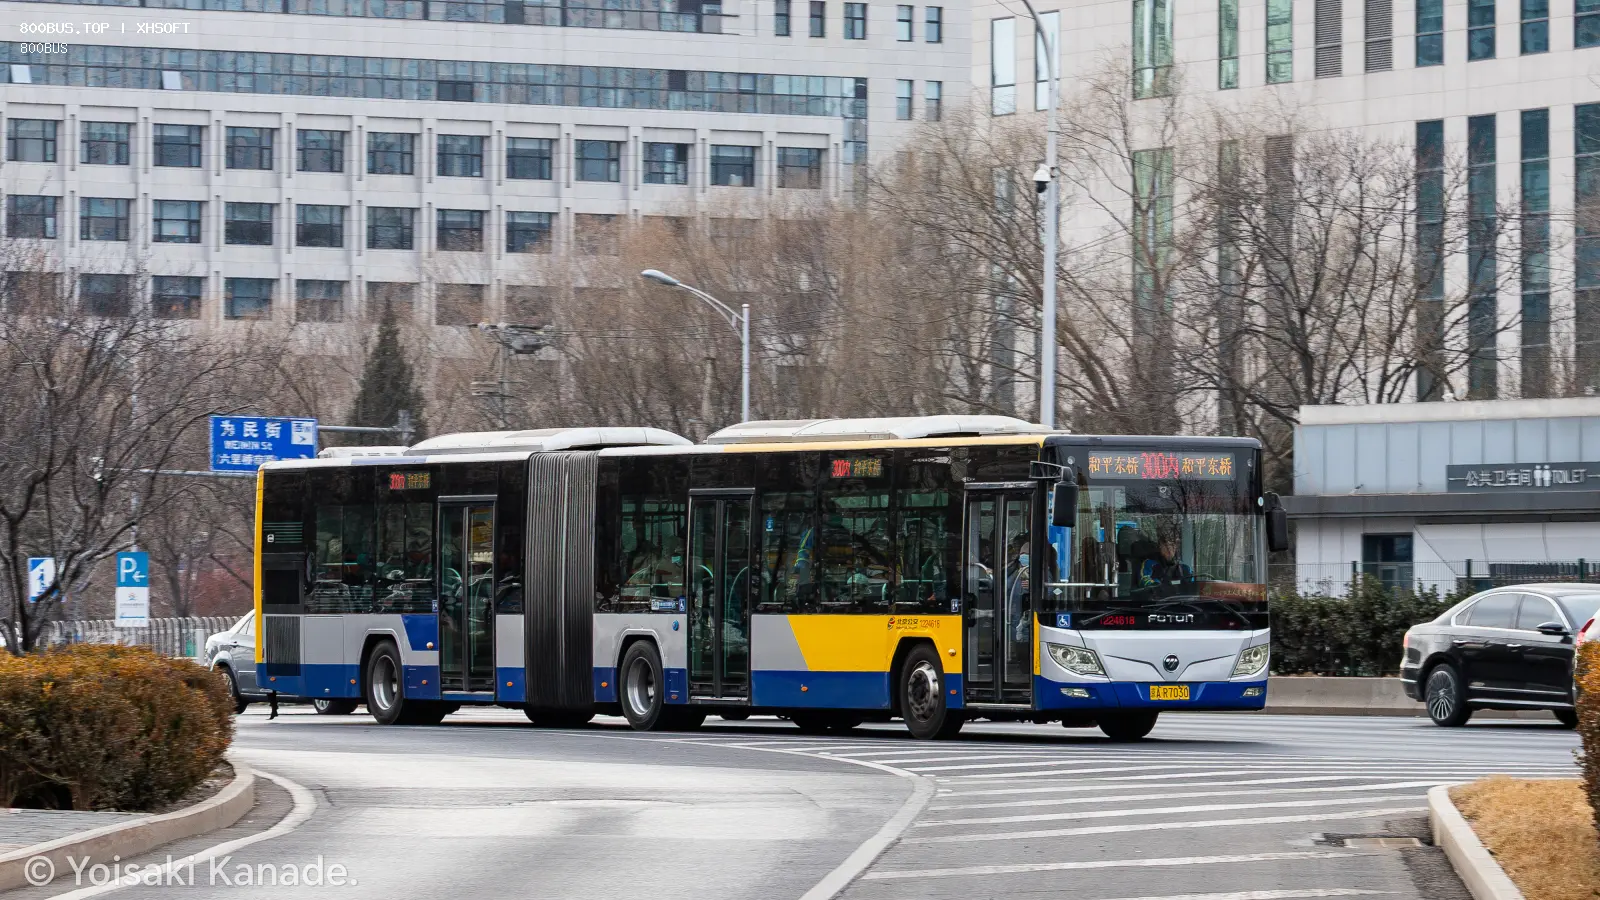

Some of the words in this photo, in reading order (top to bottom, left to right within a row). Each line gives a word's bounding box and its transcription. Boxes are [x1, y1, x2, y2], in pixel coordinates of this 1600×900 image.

[220, 420, 282, 439] 为民街
[1088, 456, 1139, 474] 和平东桥
[1140, 452, 1180, 479] 300内
[1182, 457, 1233, 475] 和平东桥
[1466, 469, 1532, 487] 公共卫生间
[1552, 469, 1588, 484] TOILET
[120, 557, 137, 583] P
